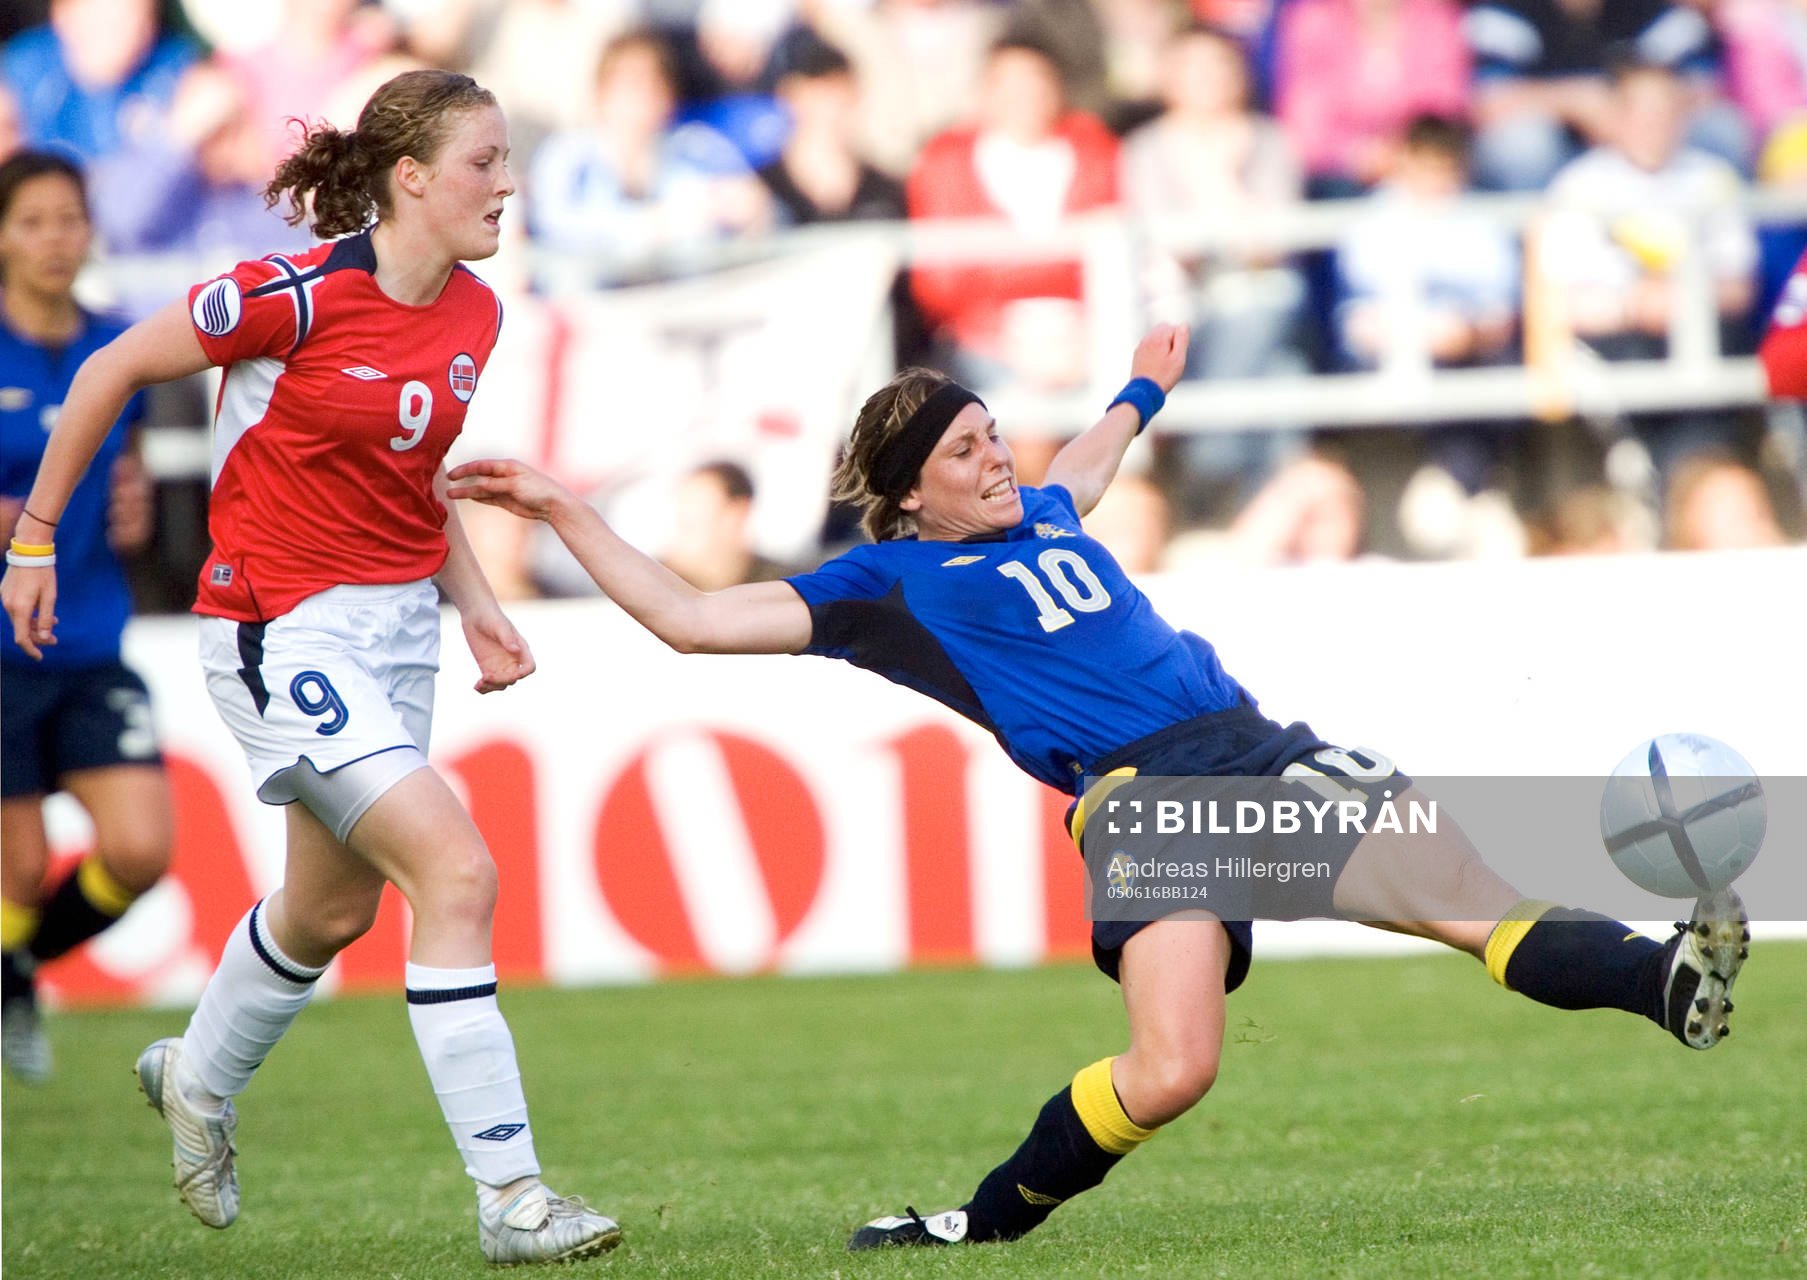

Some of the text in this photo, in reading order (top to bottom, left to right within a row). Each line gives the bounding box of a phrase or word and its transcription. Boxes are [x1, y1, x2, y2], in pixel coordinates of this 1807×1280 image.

[390, 380, 433, 452] 9
[996, 548, 1112, 633] 10
[289, 670, 349, 736] 9
[1279, 746, 1396, 818] 10
